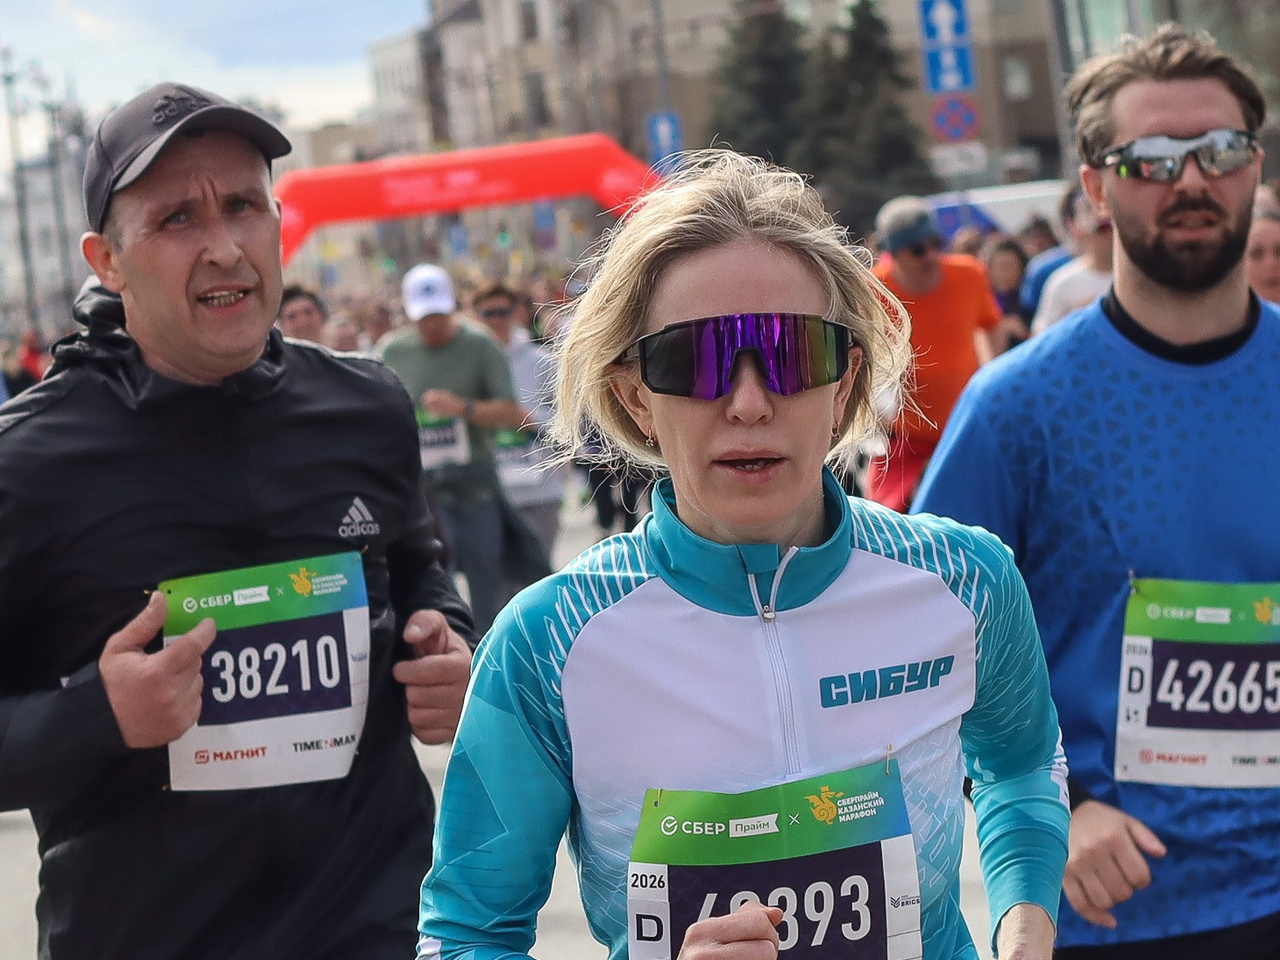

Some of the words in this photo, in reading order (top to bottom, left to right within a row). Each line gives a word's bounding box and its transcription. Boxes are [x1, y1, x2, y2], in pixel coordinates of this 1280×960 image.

[338, 522, 380, 537] adidas
[211, 635, 340, 703] 38210
[820, 655, 955, 709] СИБУР
[1127, 666, 1144, 693] D
[1156, 658, 1280, 714] 42665
[213, 746, 267, 762] МАГНИТ
[837, 791, 880, 807] СБЕРПРАЙМ
[837, 796, 885, 815] КАЗАНСКИЙ
[838, 808, 877, 823] МАРАФОН
[681, 821, 726, 835] СБЕР
[735, 820, 770, 834] Прайм
[631, 873, 665, 888] 2026
[697, 874, 871, 950] 393
[636, 914, 664, 942] D
